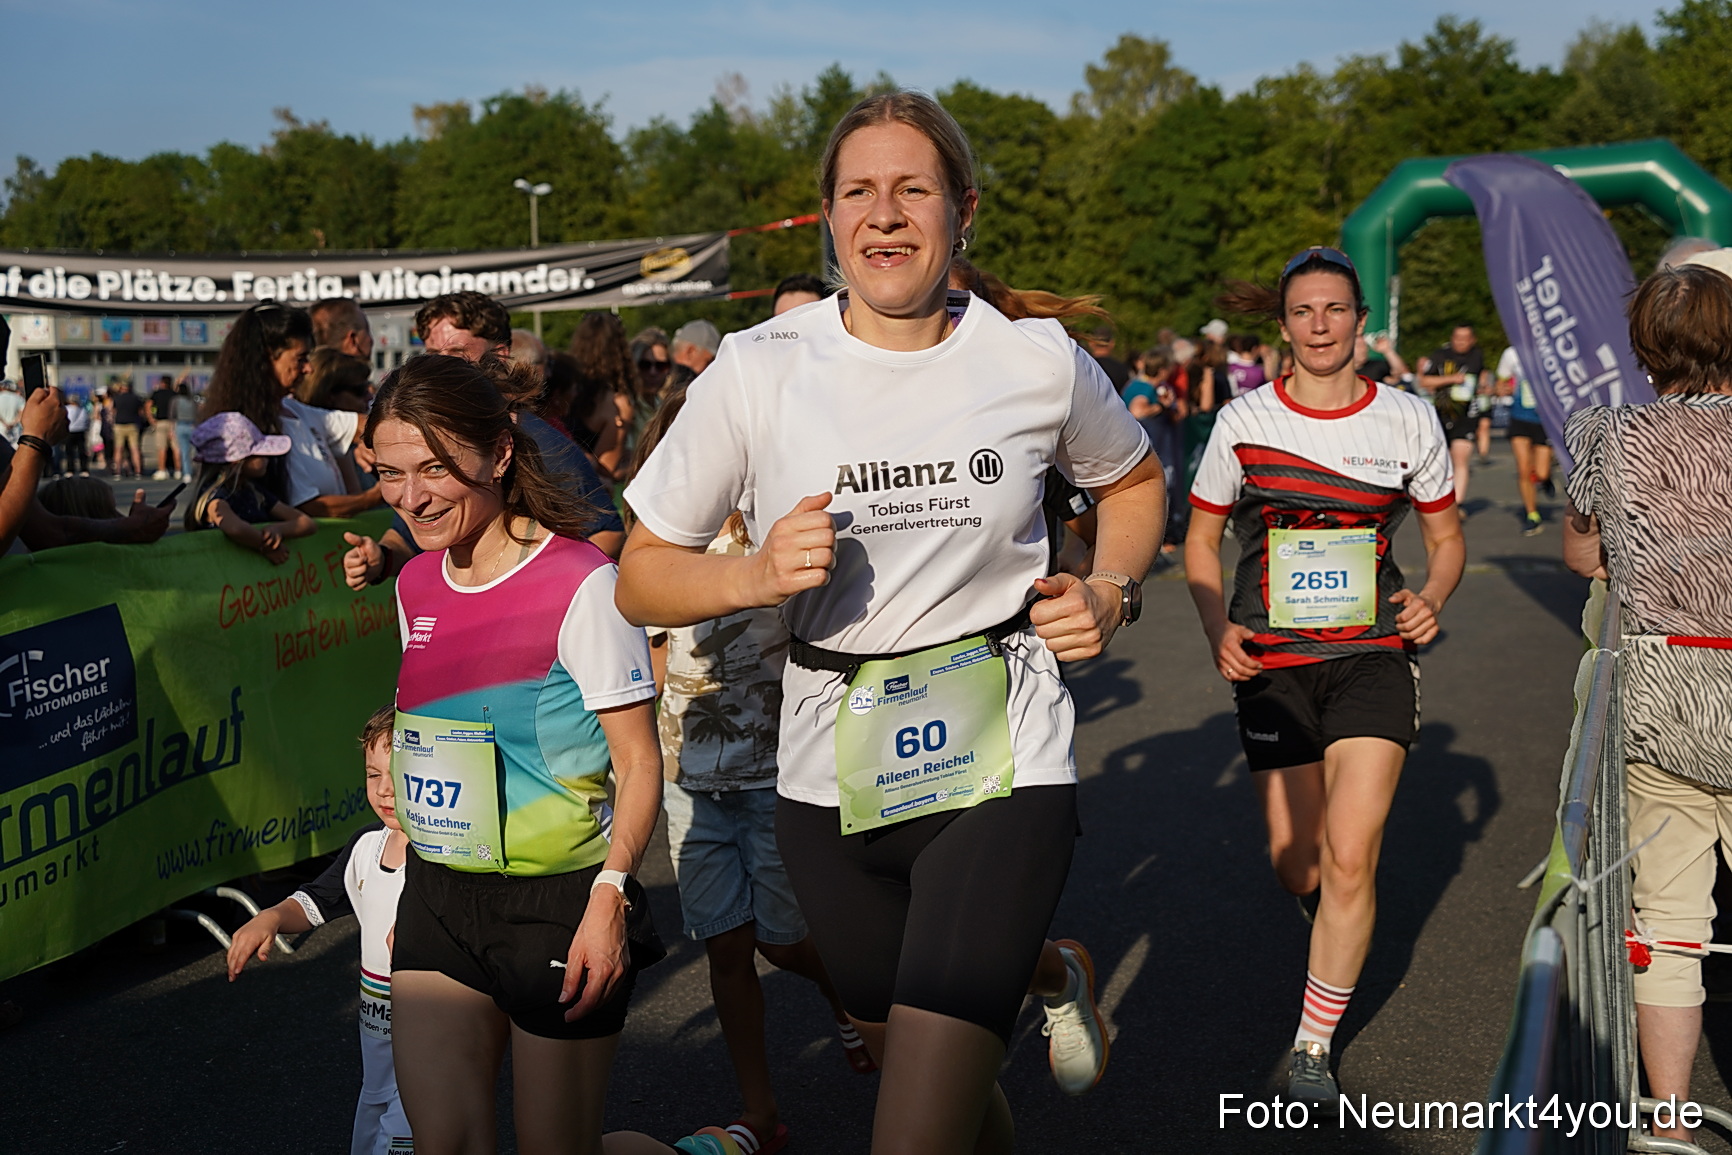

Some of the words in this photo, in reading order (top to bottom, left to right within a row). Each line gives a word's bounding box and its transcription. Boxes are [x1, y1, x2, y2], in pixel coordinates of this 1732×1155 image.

[28, 265, 92, 299] die
[97, 268, 227, 301] Plätze.
[359, 265, 596, 300] Miteinander.
[769, 331, 799, 341] JAKO
[1342, 456, 1399, 469] NEUMARKT
[834, 459, 958, 495] Allianz
[868, 501, 924, 518] Tobias
[928, 495, 971, 512] Fürst
[850, 514, 983, 536] Generalvertretung
[219, 552, 322, 629] Gesunde
[1291, 570, 1348, 590] 2651
[1285, 596, 1311, 604] Sarah
[1313, 595, 1359, 604] Schmitzer
[274, 609, 348, 671] laufen
[8, 657, 111, 708] Fischer
[877, 684, 928, 706] Firmenlauf
[25, 681, 109, 720] AUTOMOBILE
[898, 692, 928, 706] neumarkt
[50, 722, 72, 744] und
[73, 715, 94, 732] das
[895, 720, 947, 759] 60
[402, 742, 434, 753] Firmenlauf
[875, 768, 920, 787] Aileen
[923, 750, 975, 775] Reichel
[404, 773, 462, 809] 1737
[405, 808, 426, 826] Katja
[427, 815, 471, 830] Lechner
